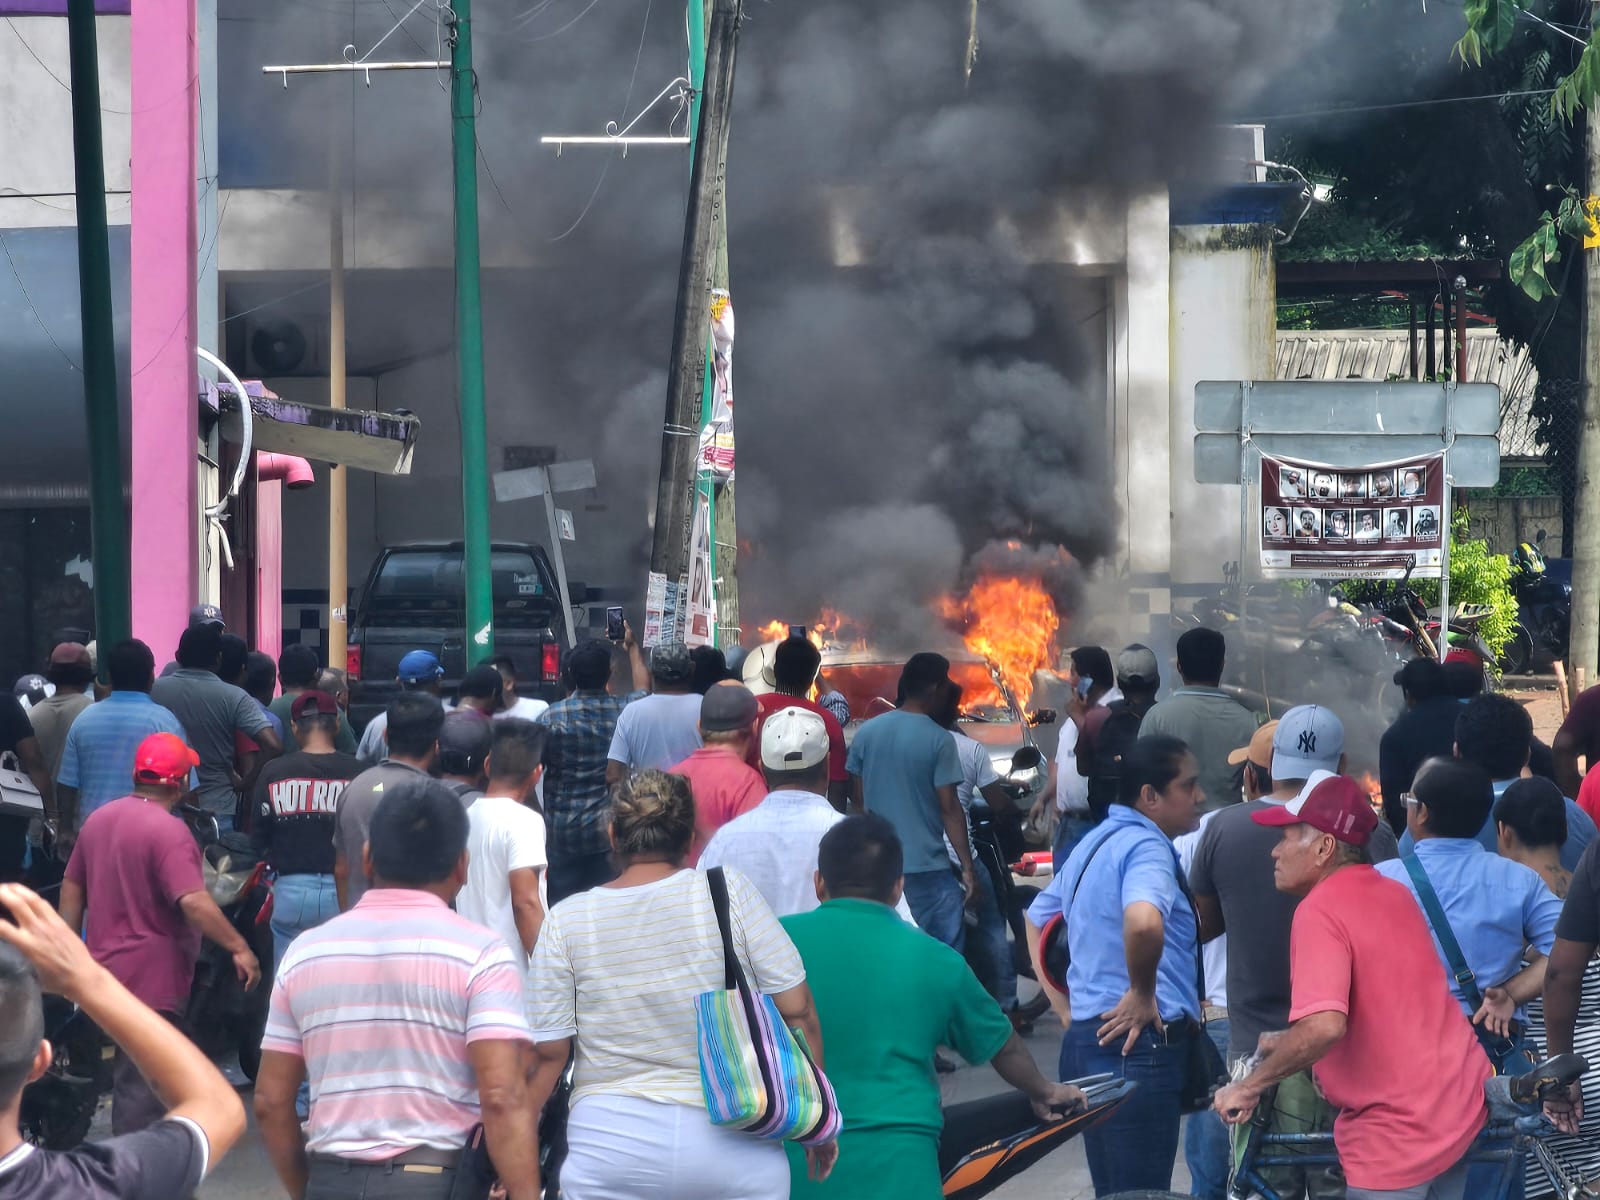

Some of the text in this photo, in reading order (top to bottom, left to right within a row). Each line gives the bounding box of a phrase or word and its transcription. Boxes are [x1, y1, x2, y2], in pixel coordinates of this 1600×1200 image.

[1297, 730, 1317, 753] NY
[272, 780, 350, 815] HOT RO
